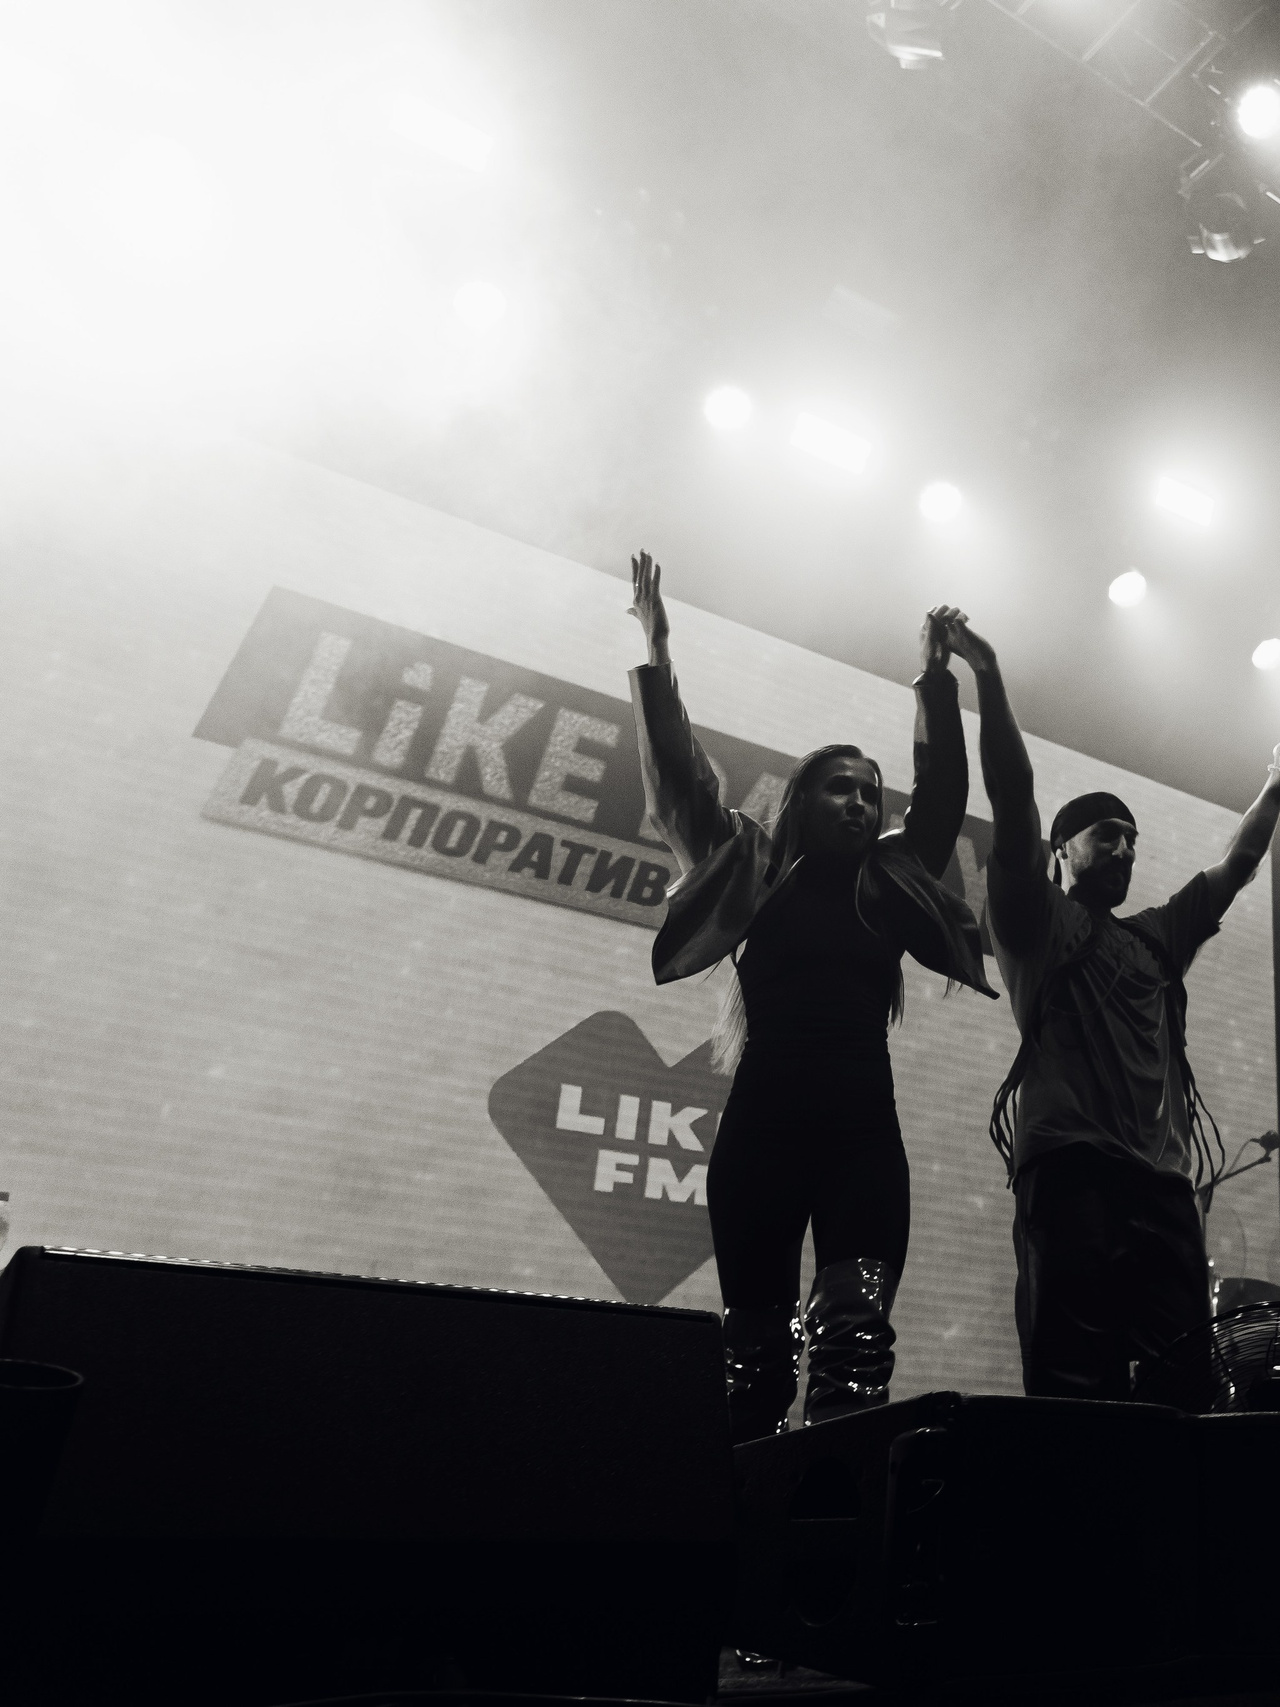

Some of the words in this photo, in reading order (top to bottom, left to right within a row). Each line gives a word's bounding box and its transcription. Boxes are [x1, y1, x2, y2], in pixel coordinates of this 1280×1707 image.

[239, 758, 673, 907] КОРПОРАТИВ
[556, 1083, 723, 1152] LIK
[594, 1149, 709, 1206] FM
